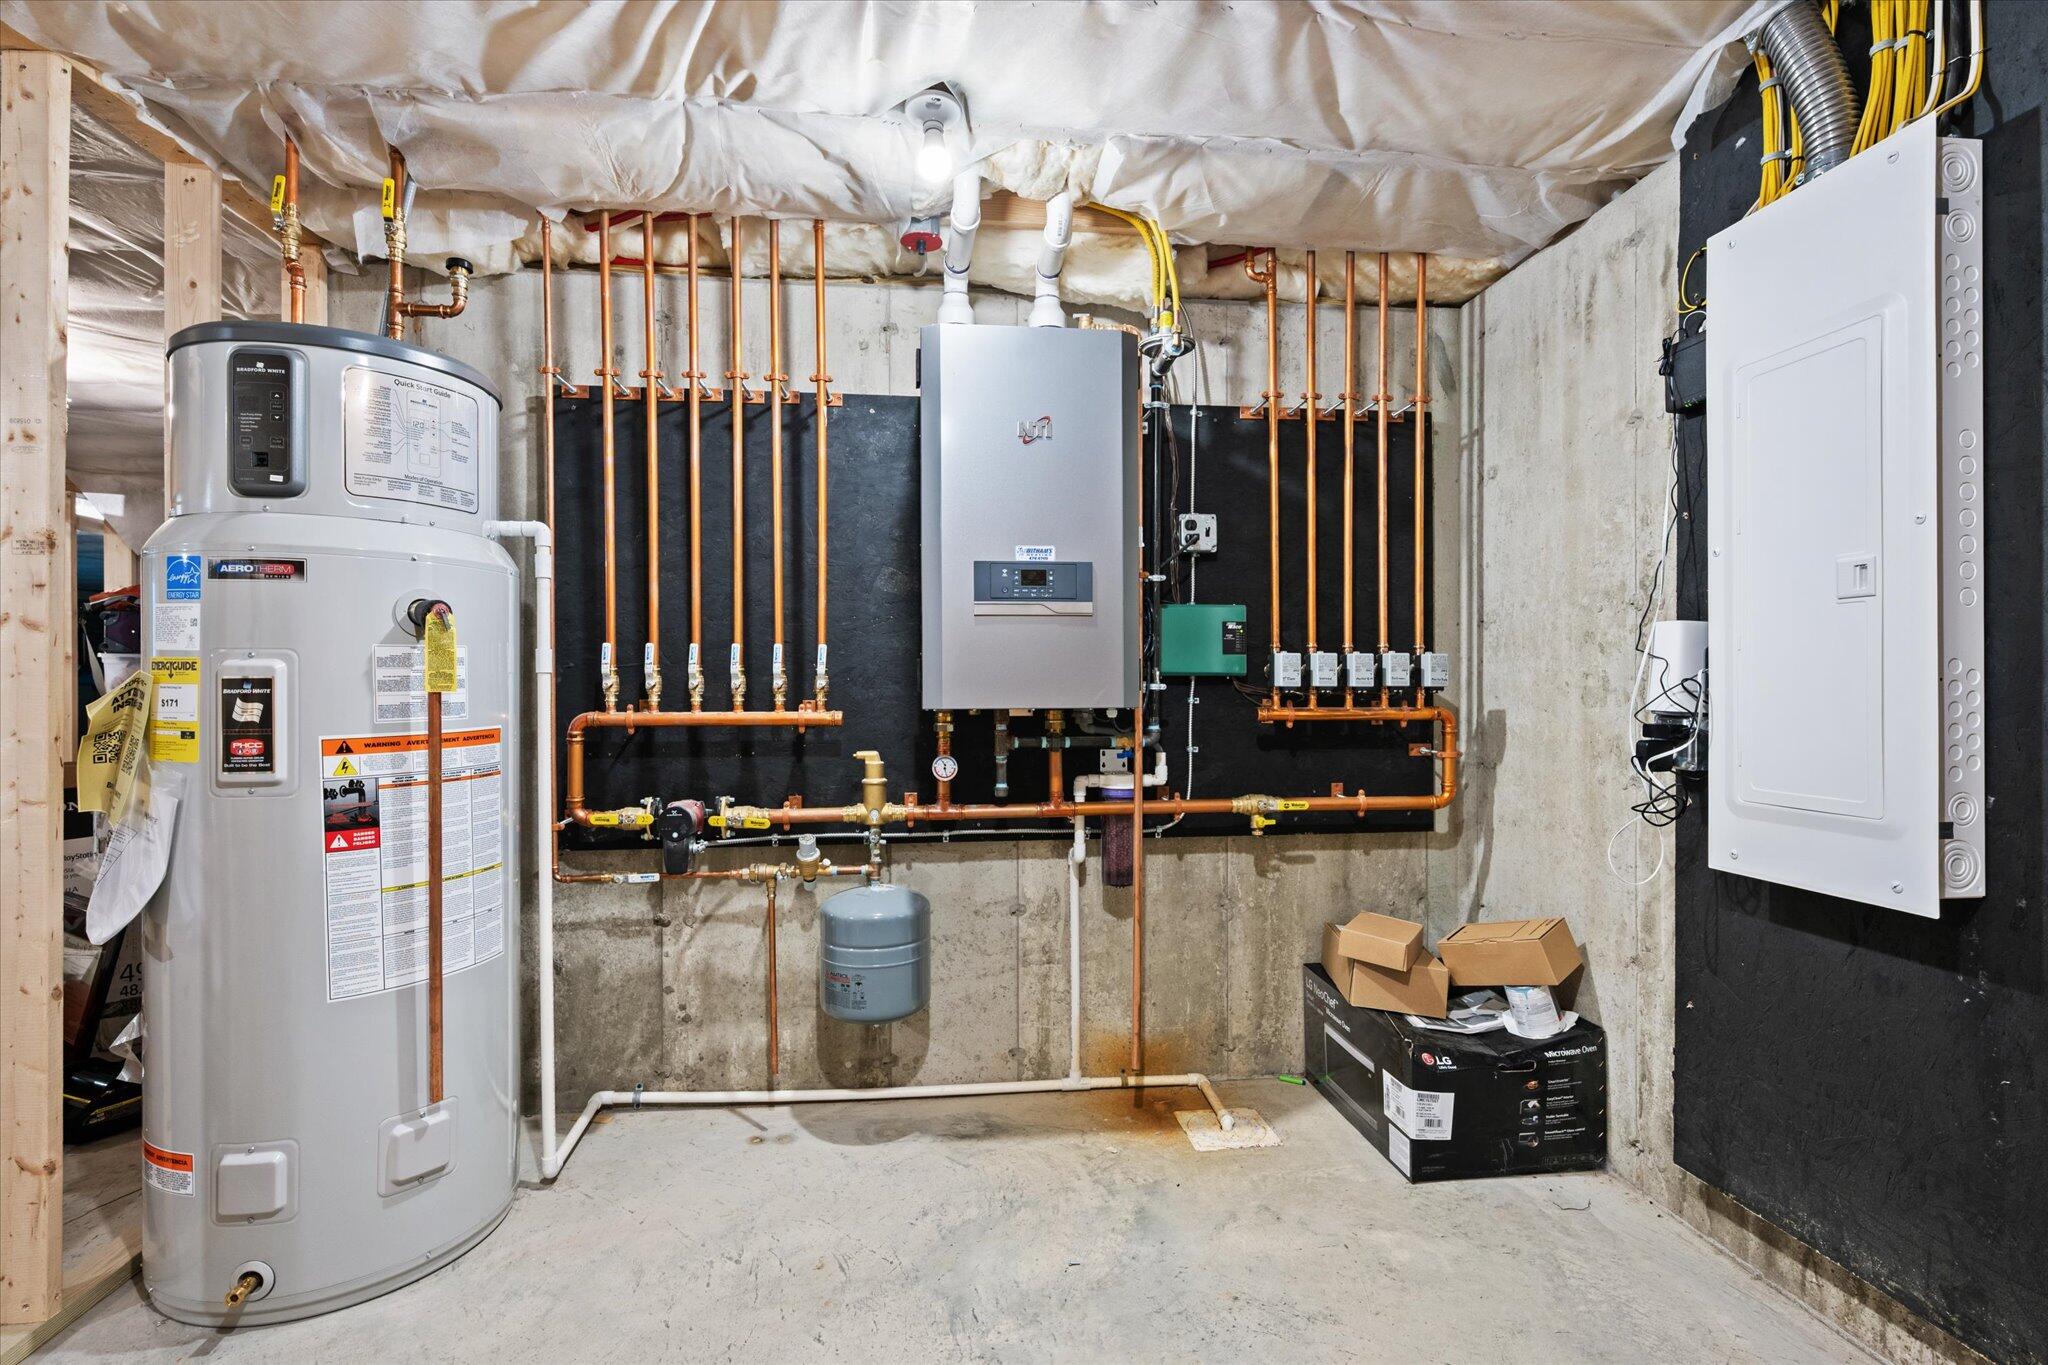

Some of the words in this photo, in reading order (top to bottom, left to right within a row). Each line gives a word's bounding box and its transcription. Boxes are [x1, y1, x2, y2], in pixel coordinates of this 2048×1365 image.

[393, 378, 415, 389] Quick
[416, 383, 433, 394] Start
[433, 387, 452, 399] Guide
[167, 591, 185, 599] ENERGY
[186, 591, 200, 599] STAR
[161, 698, 179, 708] $171
[363, 741, 401, 749] WARNING
[1305, 975, 1313, 991] LG
[1341, 1020, 1351, 1033] Oven
[1544, 1048, 1582, 1058] Microwave
[1581, 1045, 1598, 1054] Oven
[1435, 1055, 1452, 1065] LG
